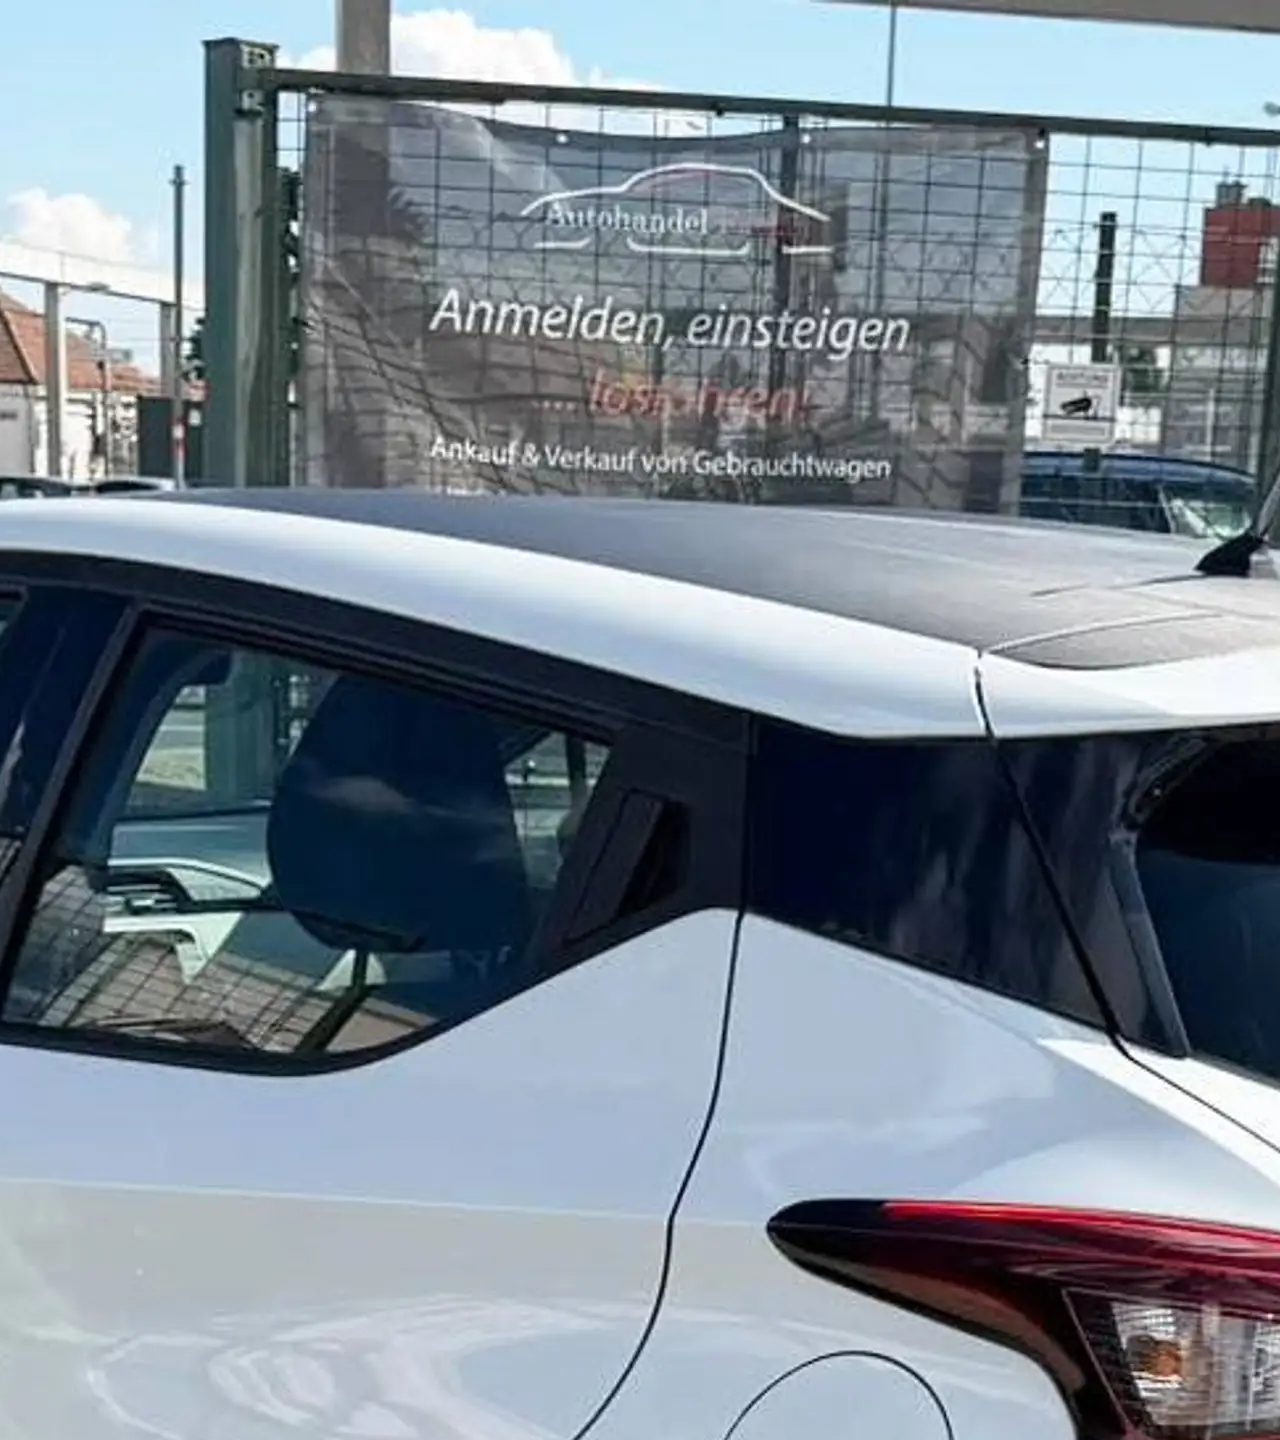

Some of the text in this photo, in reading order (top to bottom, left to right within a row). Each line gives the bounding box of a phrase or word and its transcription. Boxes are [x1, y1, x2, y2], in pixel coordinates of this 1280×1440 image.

[544, 202, 708, 236] Autohandel
[429, 288, 910, 360] Anmelden, einsteigen
[430, 434, 892, 485] Ankauf & Verkauf von Gebrauchtwagen
